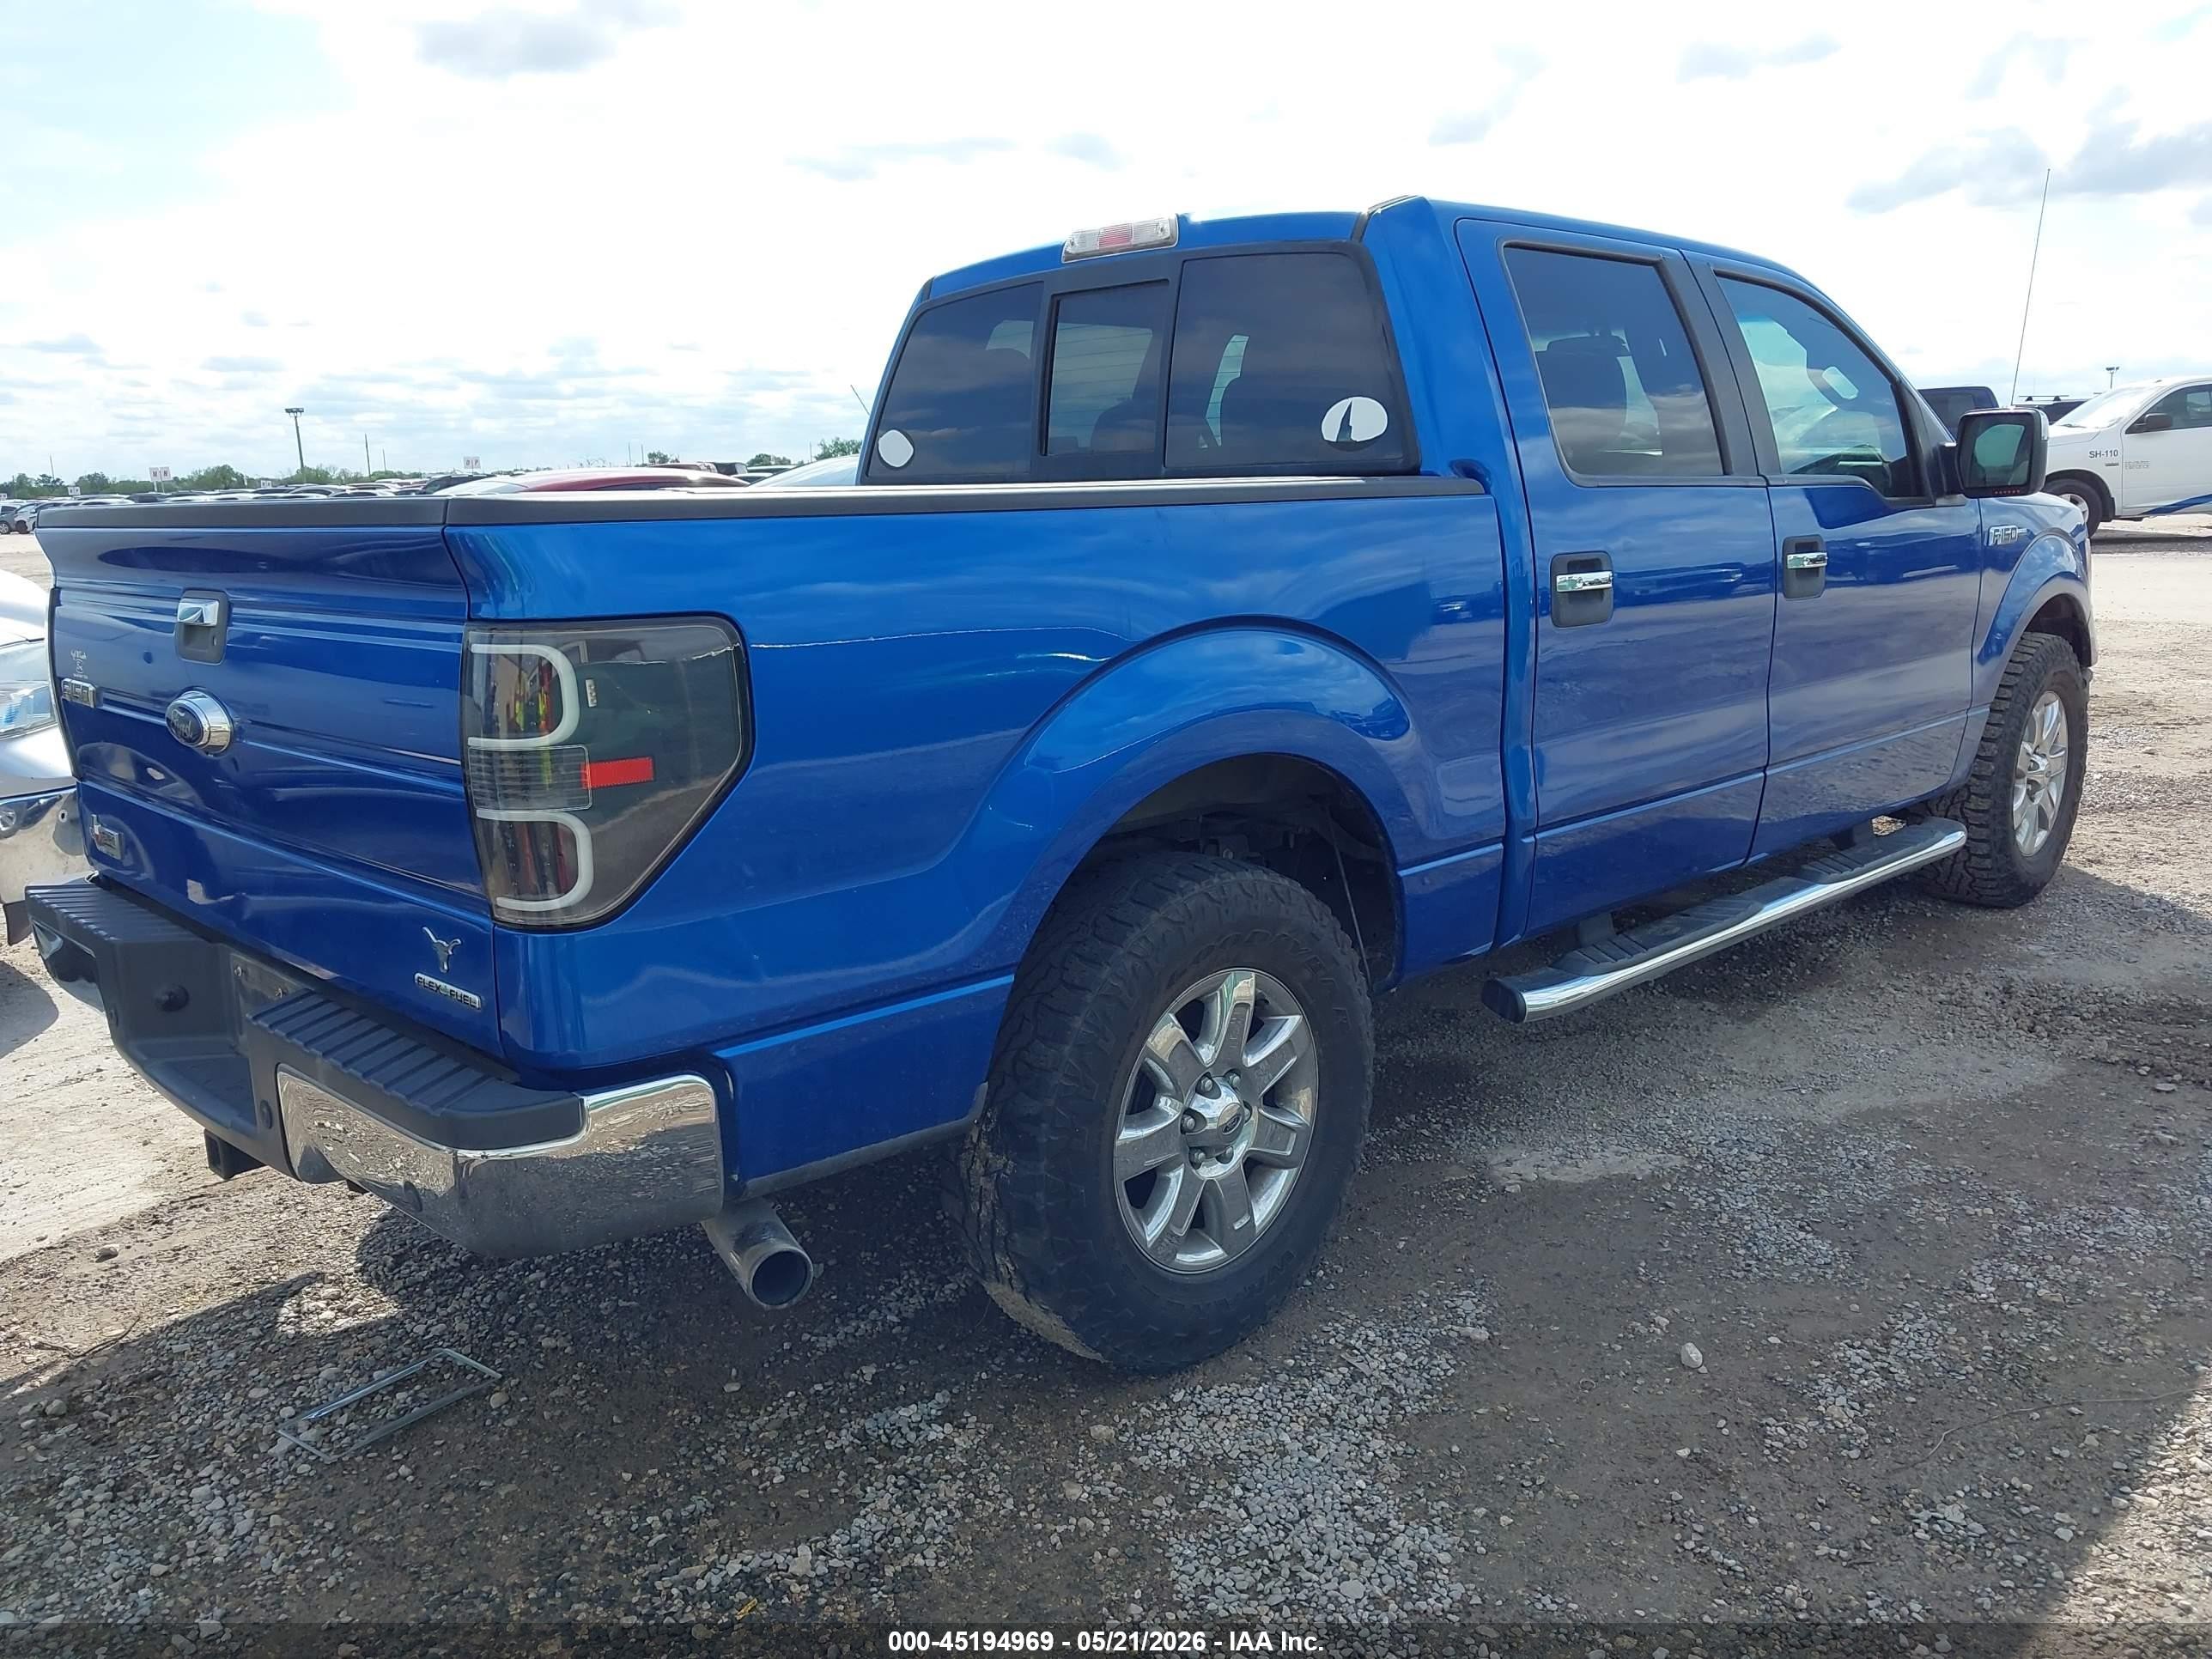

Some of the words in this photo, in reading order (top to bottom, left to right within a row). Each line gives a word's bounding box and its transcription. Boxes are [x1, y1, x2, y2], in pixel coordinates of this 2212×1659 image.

[2088, 449, 2118, 459] SH-110
[170, 708, 193, 741] Ford
[416, 975, 441, 994] FLEX
[448, 988, 477, 1008] FUEL
